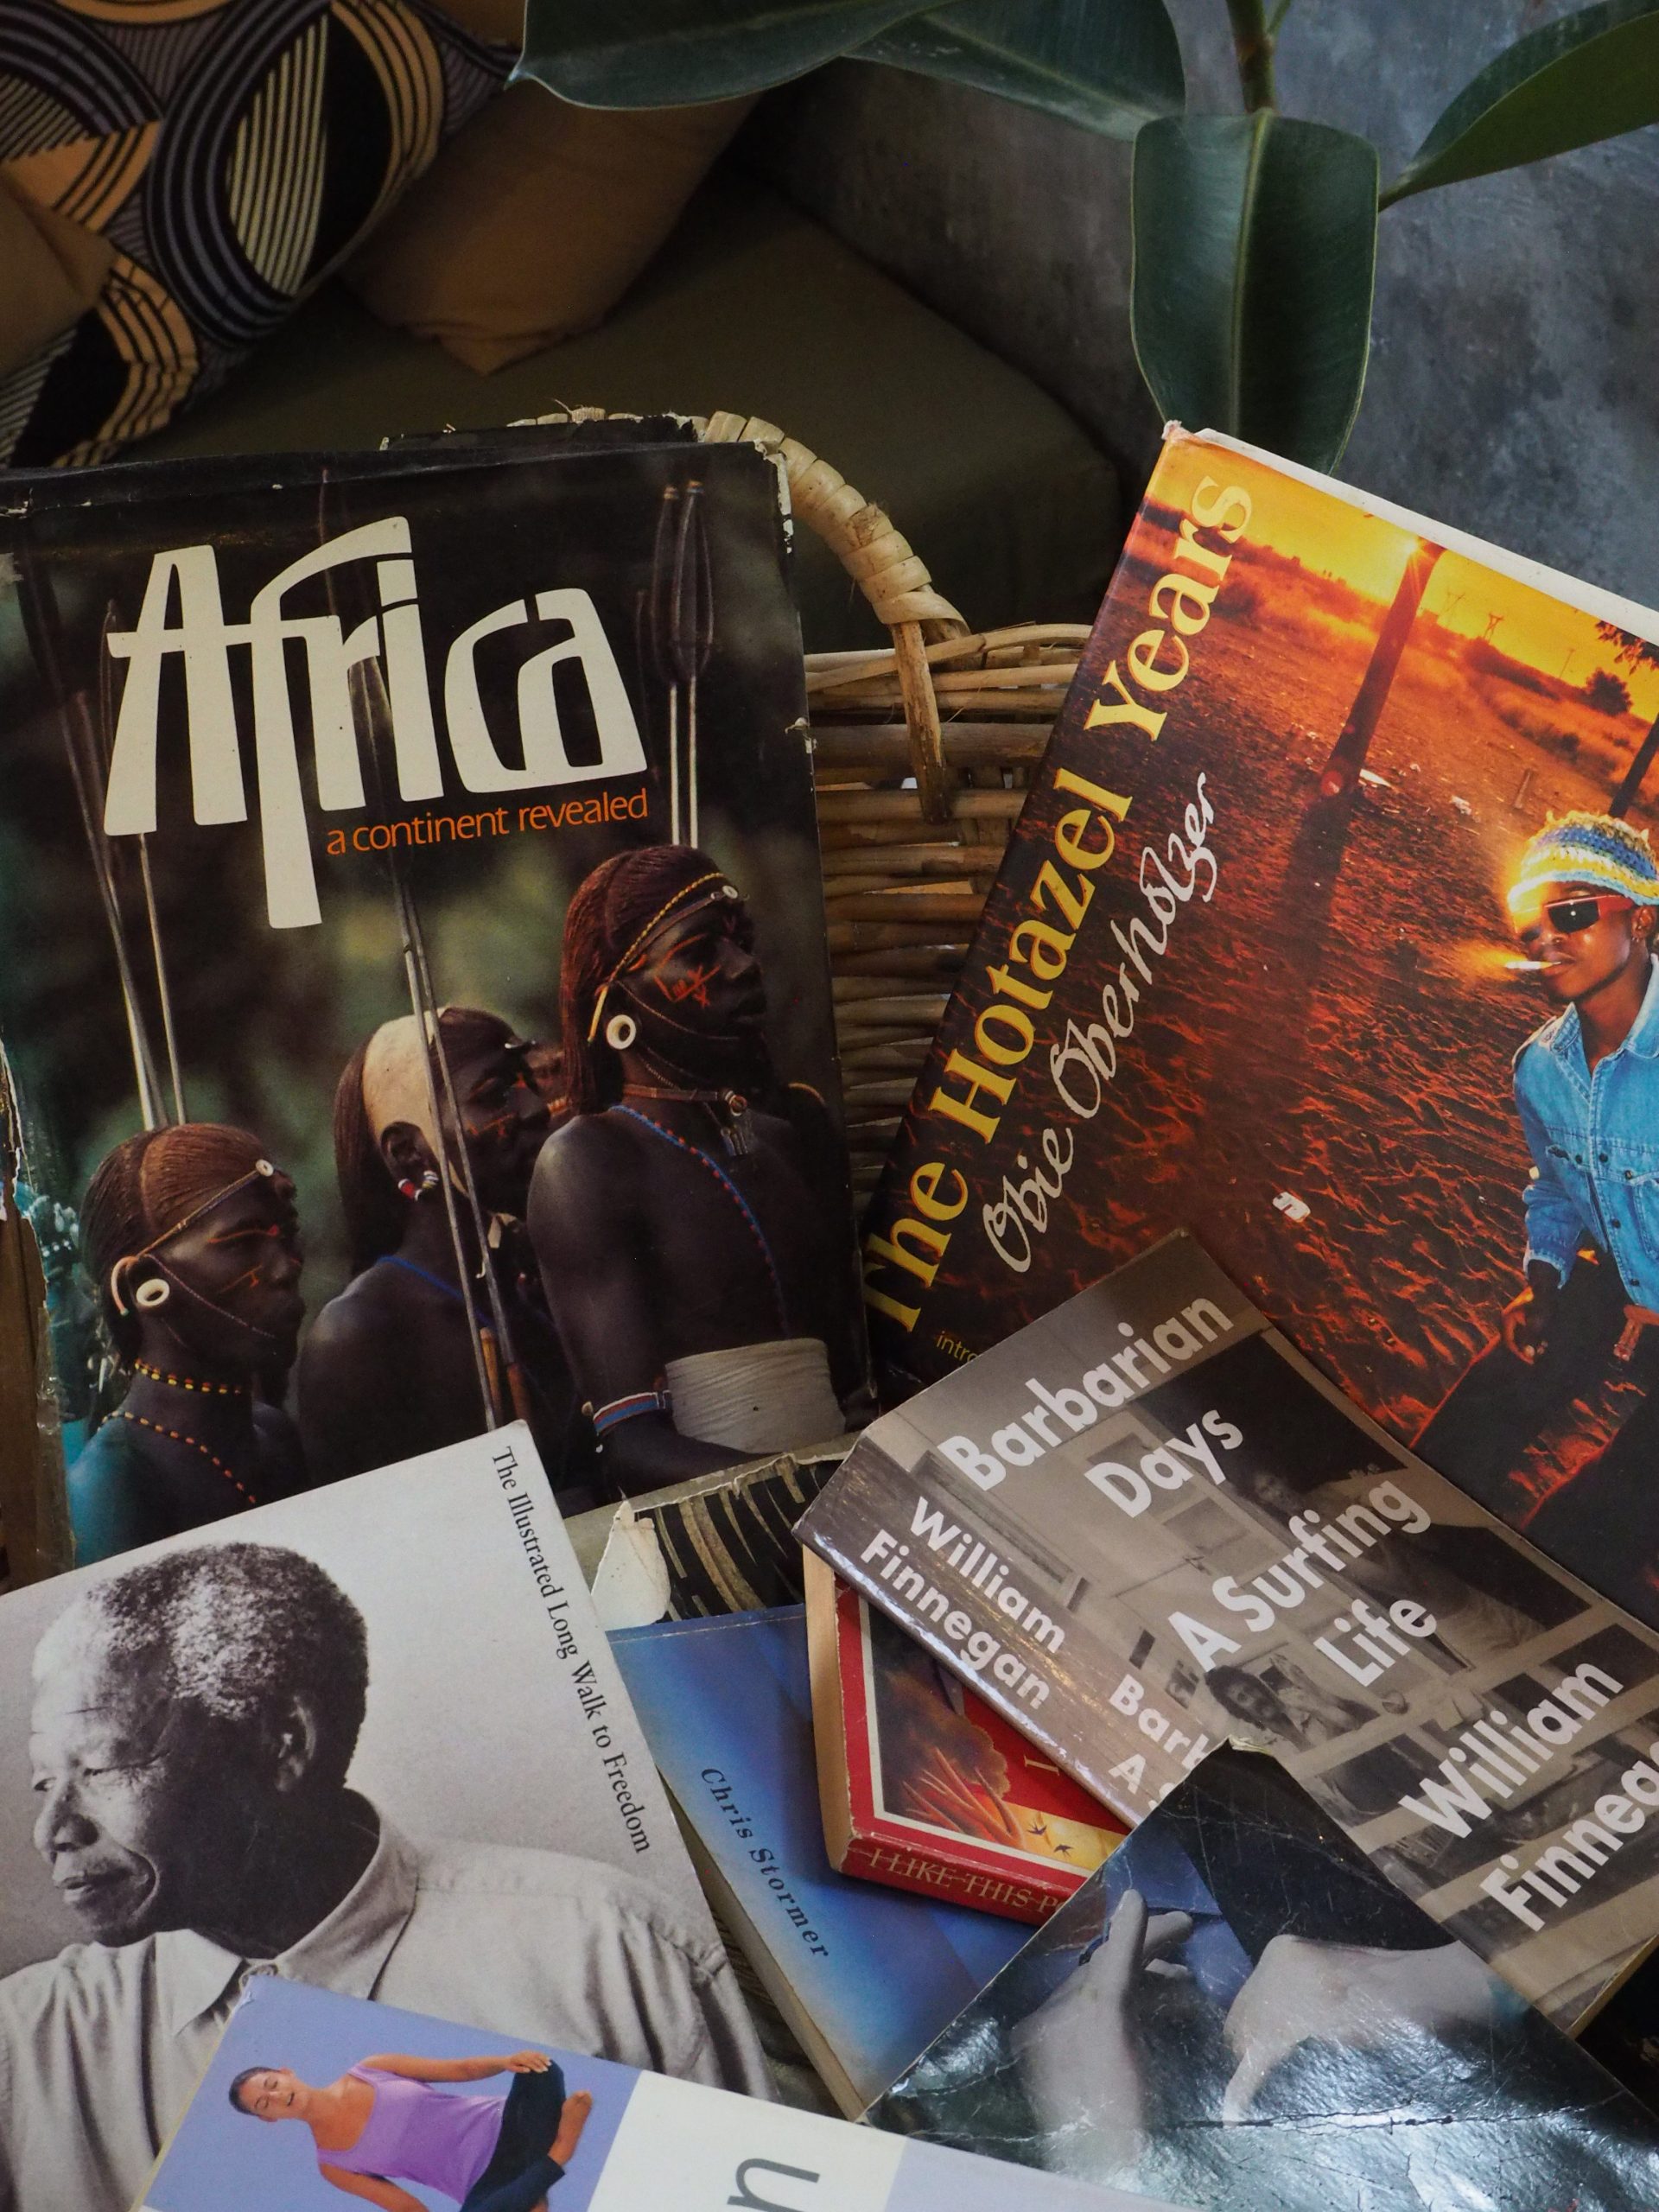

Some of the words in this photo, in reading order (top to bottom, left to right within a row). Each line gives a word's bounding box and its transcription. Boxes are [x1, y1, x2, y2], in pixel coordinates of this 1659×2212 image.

[104, 516, 648, 929] Africa
[928, 767, 1134, 1145] Hotazel
[1084, 476, 1253, 741] Years
[326, 828, 346, 855] a
[352, 807, 508, 855] continent
[518, 788, 649, 833] revealed
[982, 1128, 1074, 1273] Obie
[1050, 772, 1217, 1119] Oberholzer
[938, 1294, 1235, 1491] Barbarian
[1084, 1409, 1244, 1517] Days
[492, 1446, 516, 1491] The
[507, 1492, 564, 1598] Illustrated
[548, 1599, 578, 1660] Long
[571, 1659, 607, 1720] Walk
[591, 1724, 611, 1749] to
[603, 1751, 650, 1854] Freedom
[861, 1529, 1050, 1709] Finnegan
[910, 1496, 1065, 1654] William
[1168, 1611, 1242, 1672] A
[1212, 1480, 1432, 1632] Surfing
[1313, 1598, 1438, 1687] Life
[1108, 1753, 1146, 1795] A
[1398, 1662, 1624, 1839] William
[1479, 1741, 1659, 1932] Finneg
[702, 1767, 753, 1840] Chris
[750, 1847, 830, 1958] Stormer
[963, 1872, 1033, 1907] THIS
